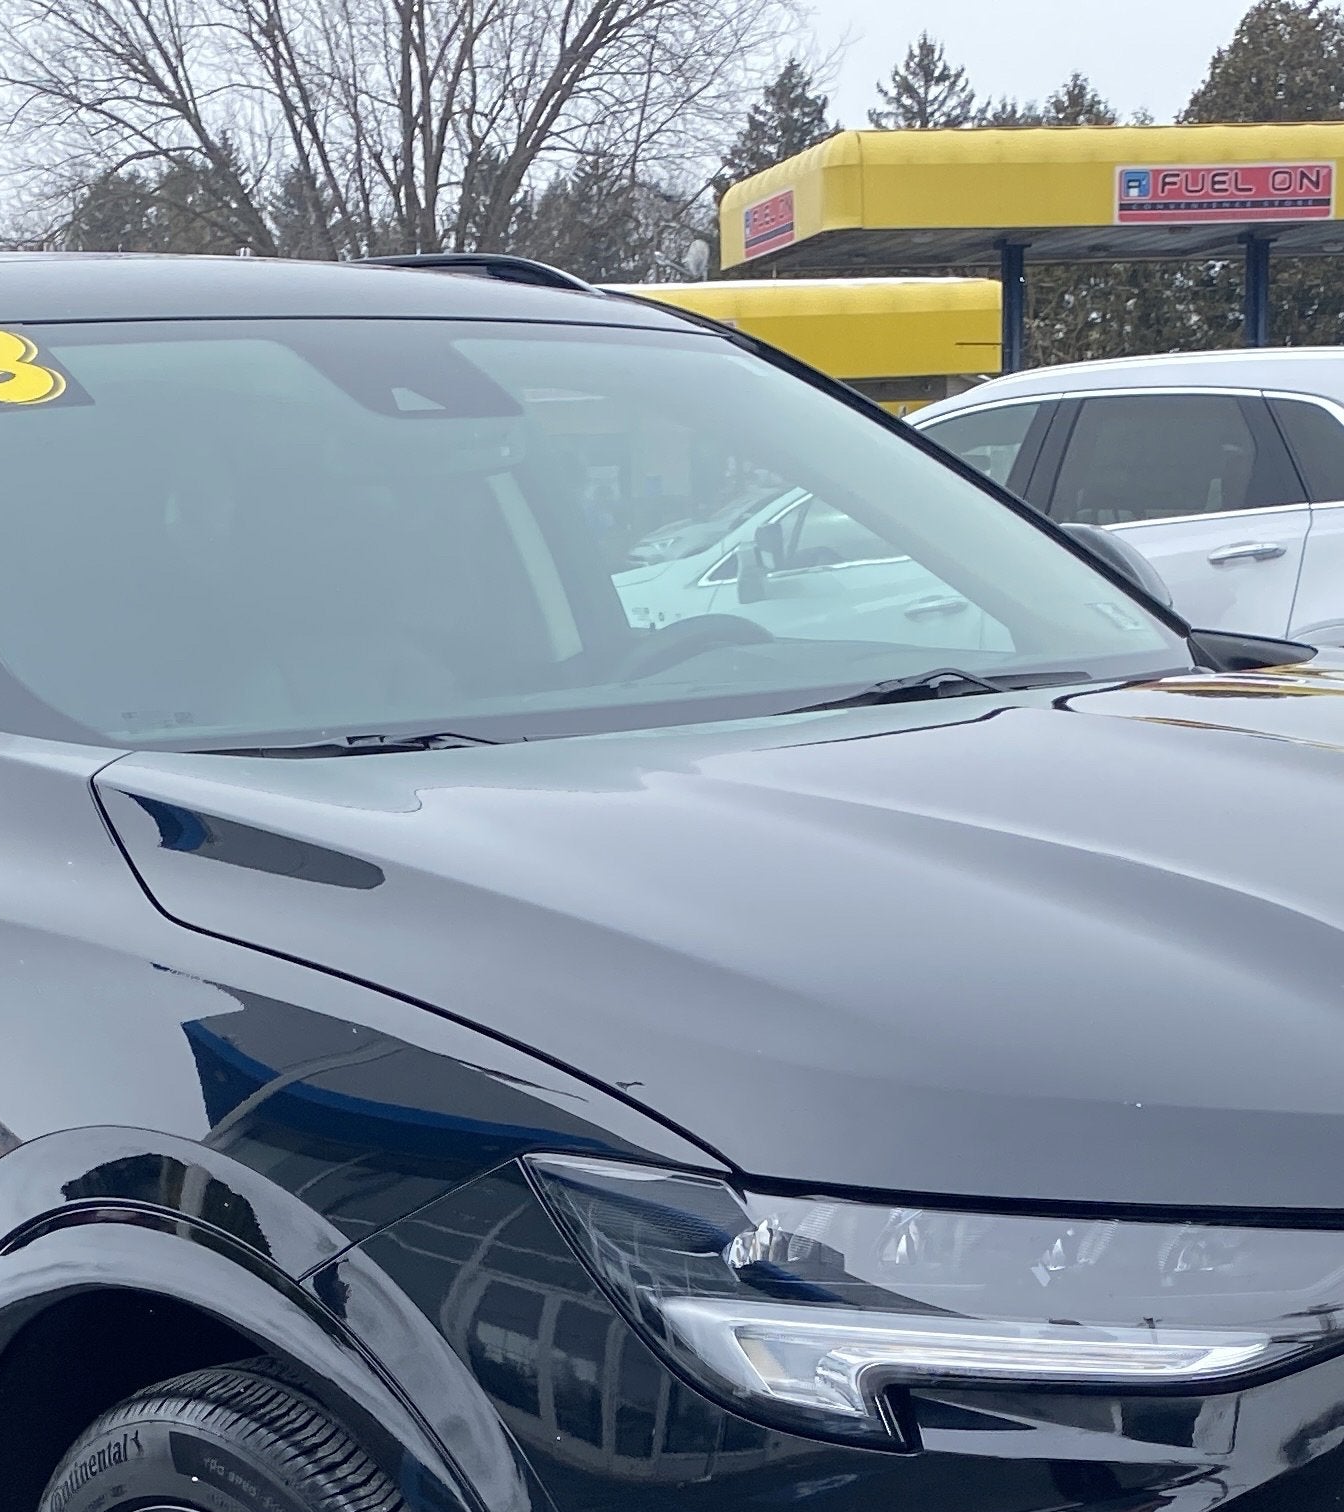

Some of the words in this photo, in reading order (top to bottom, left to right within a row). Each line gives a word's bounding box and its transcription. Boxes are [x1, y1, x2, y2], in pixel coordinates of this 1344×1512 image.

[1159, 170, 1255, 195] FUEL
[1270, 169, 1324, 192] ON
[1131, 200, 1252, 210] CONVENIENCE
[1262, 199, 1314, 207] STORE
